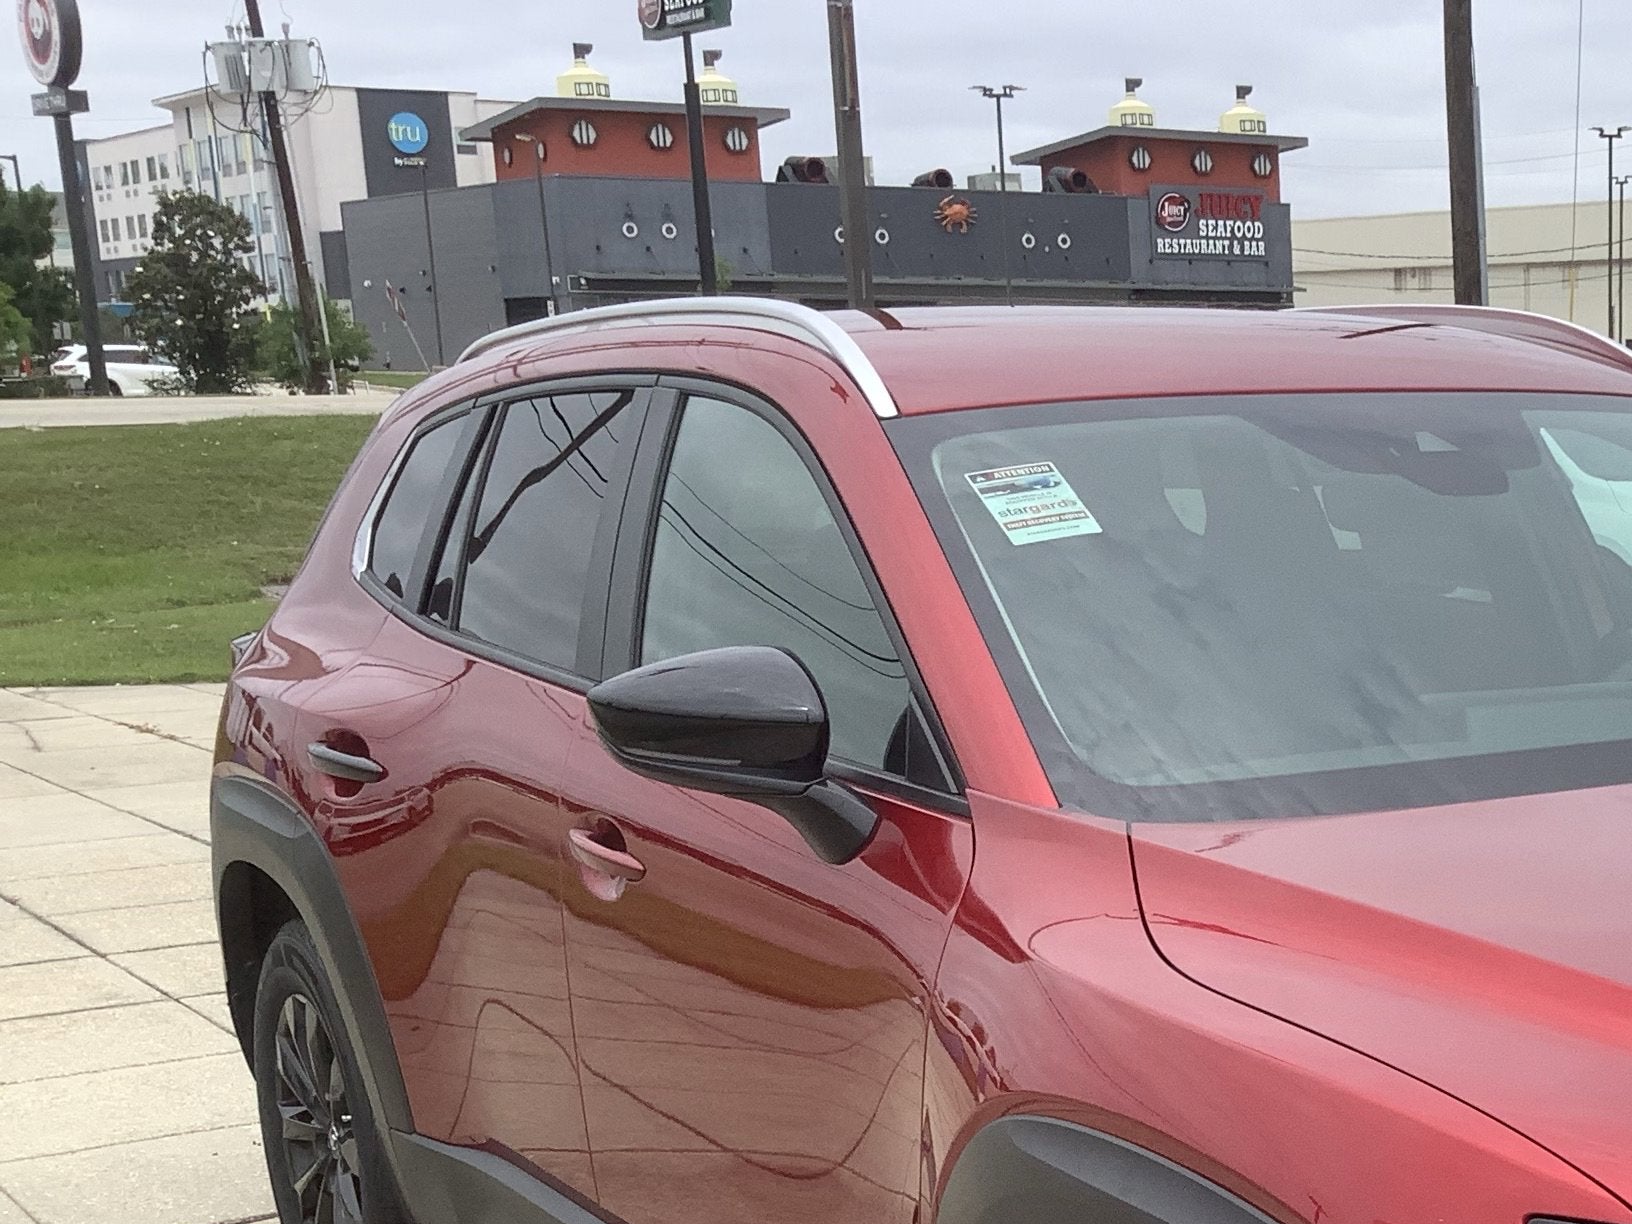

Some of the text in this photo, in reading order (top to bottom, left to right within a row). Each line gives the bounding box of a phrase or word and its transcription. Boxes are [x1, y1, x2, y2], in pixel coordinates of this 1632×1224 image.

[388, 122, 421, 142] tru
[1194, 192, 1264, 219] JUICY
[1198, 219, 1264, 238] SEAFOOD
[1156, 238, 1266, 256] RESTAURANT & BAR
[993, 465, 1050, 479] ATTENTION
